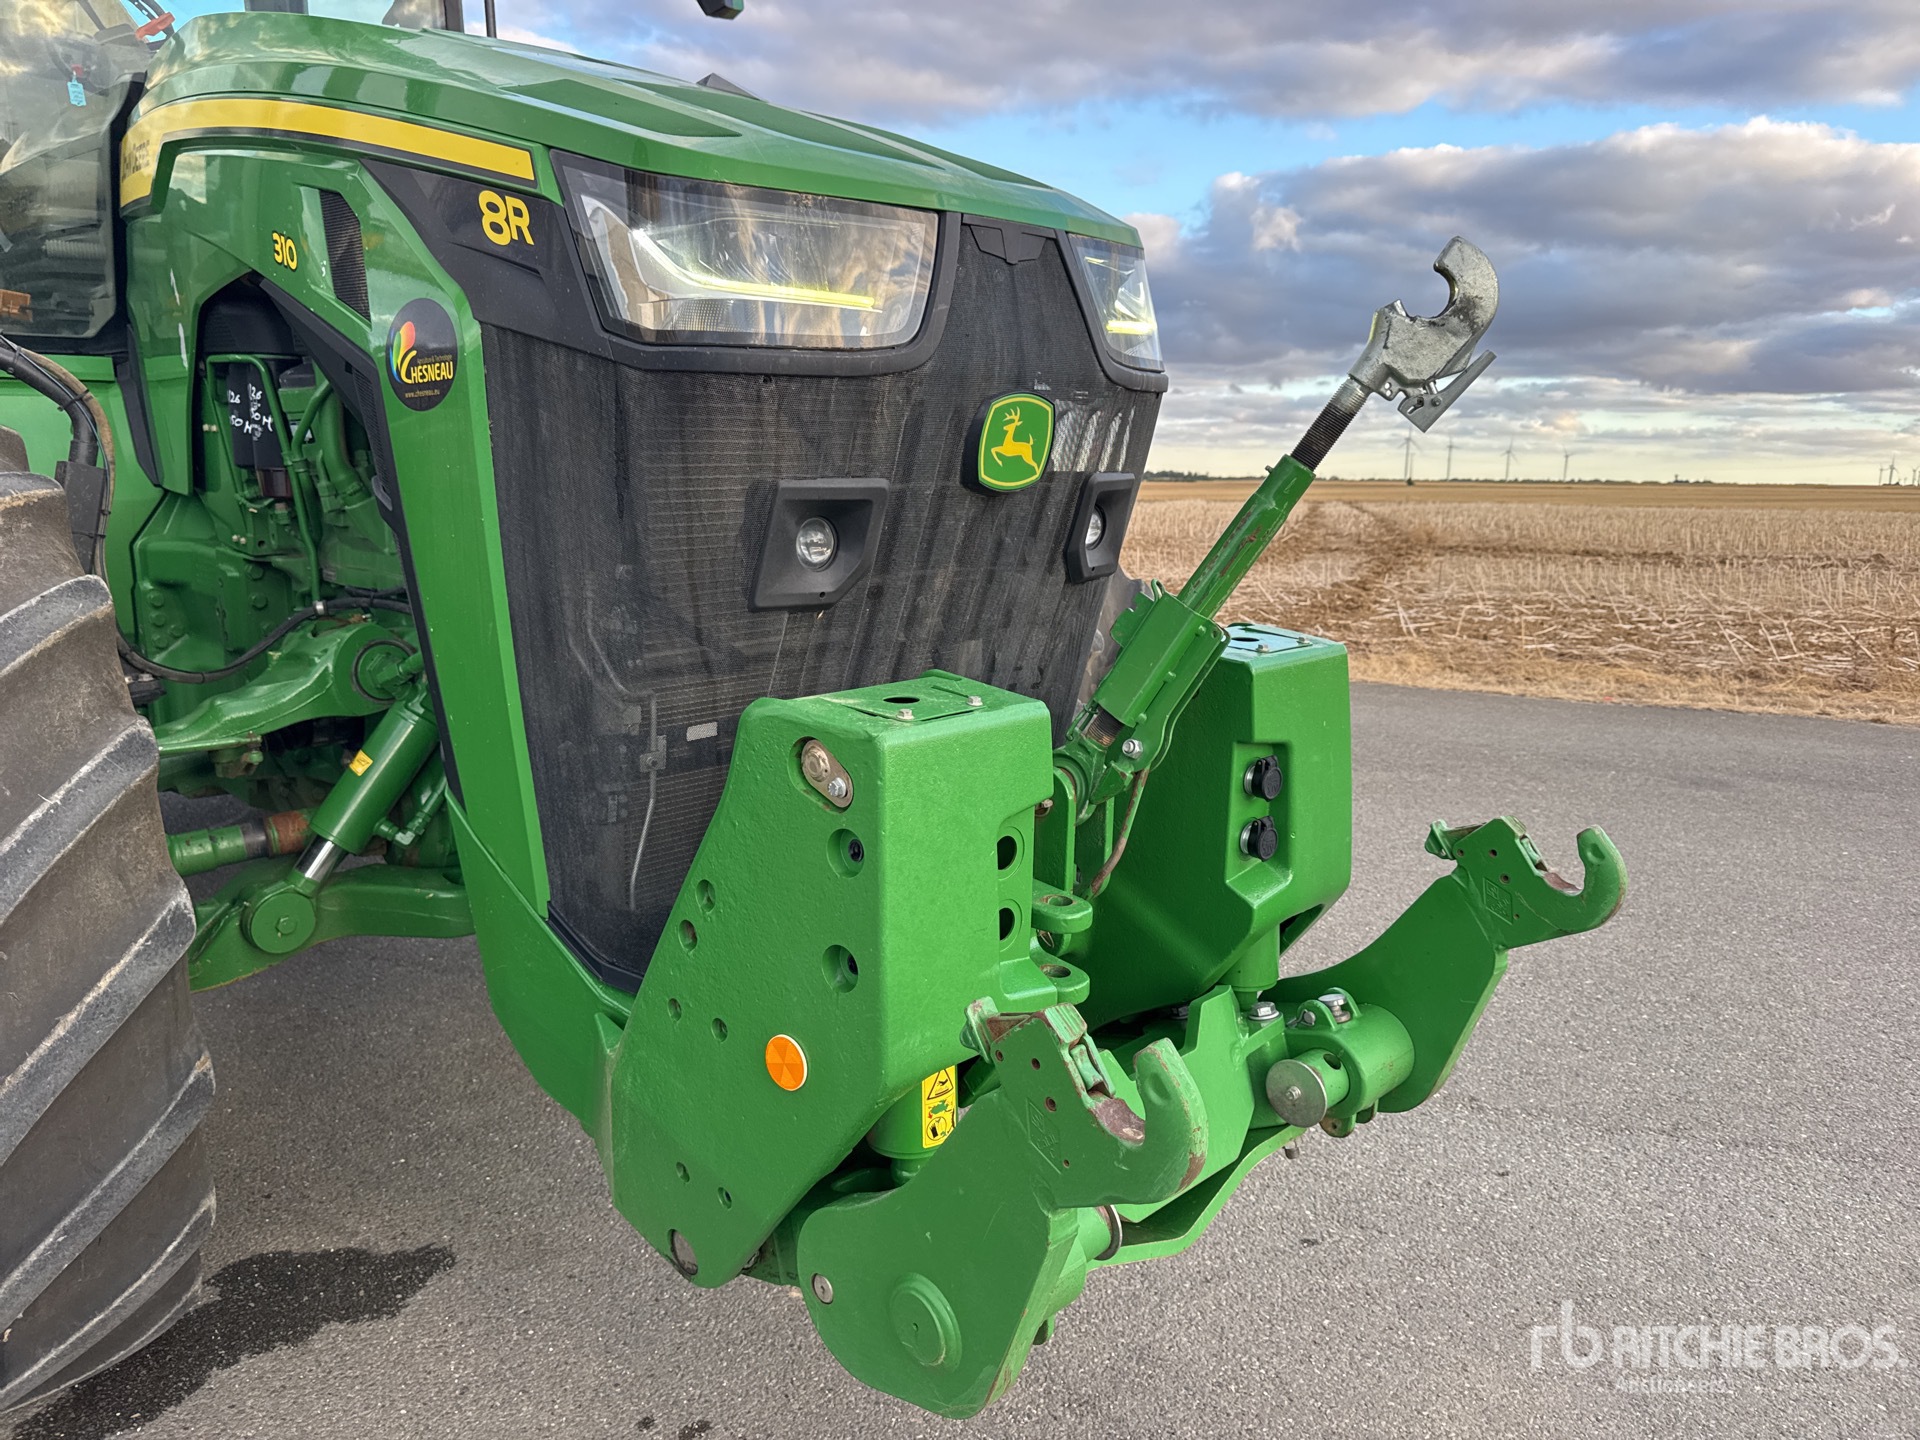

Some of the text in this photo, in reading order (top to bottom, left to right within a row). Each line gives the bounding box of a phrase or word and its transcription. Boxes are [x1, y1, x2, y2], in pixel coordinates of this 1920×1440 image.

[479, 190, 534, 246] 8R
[272, 231, 298, 271] 310
[401, 350, 453, 384] CHESNEAU
